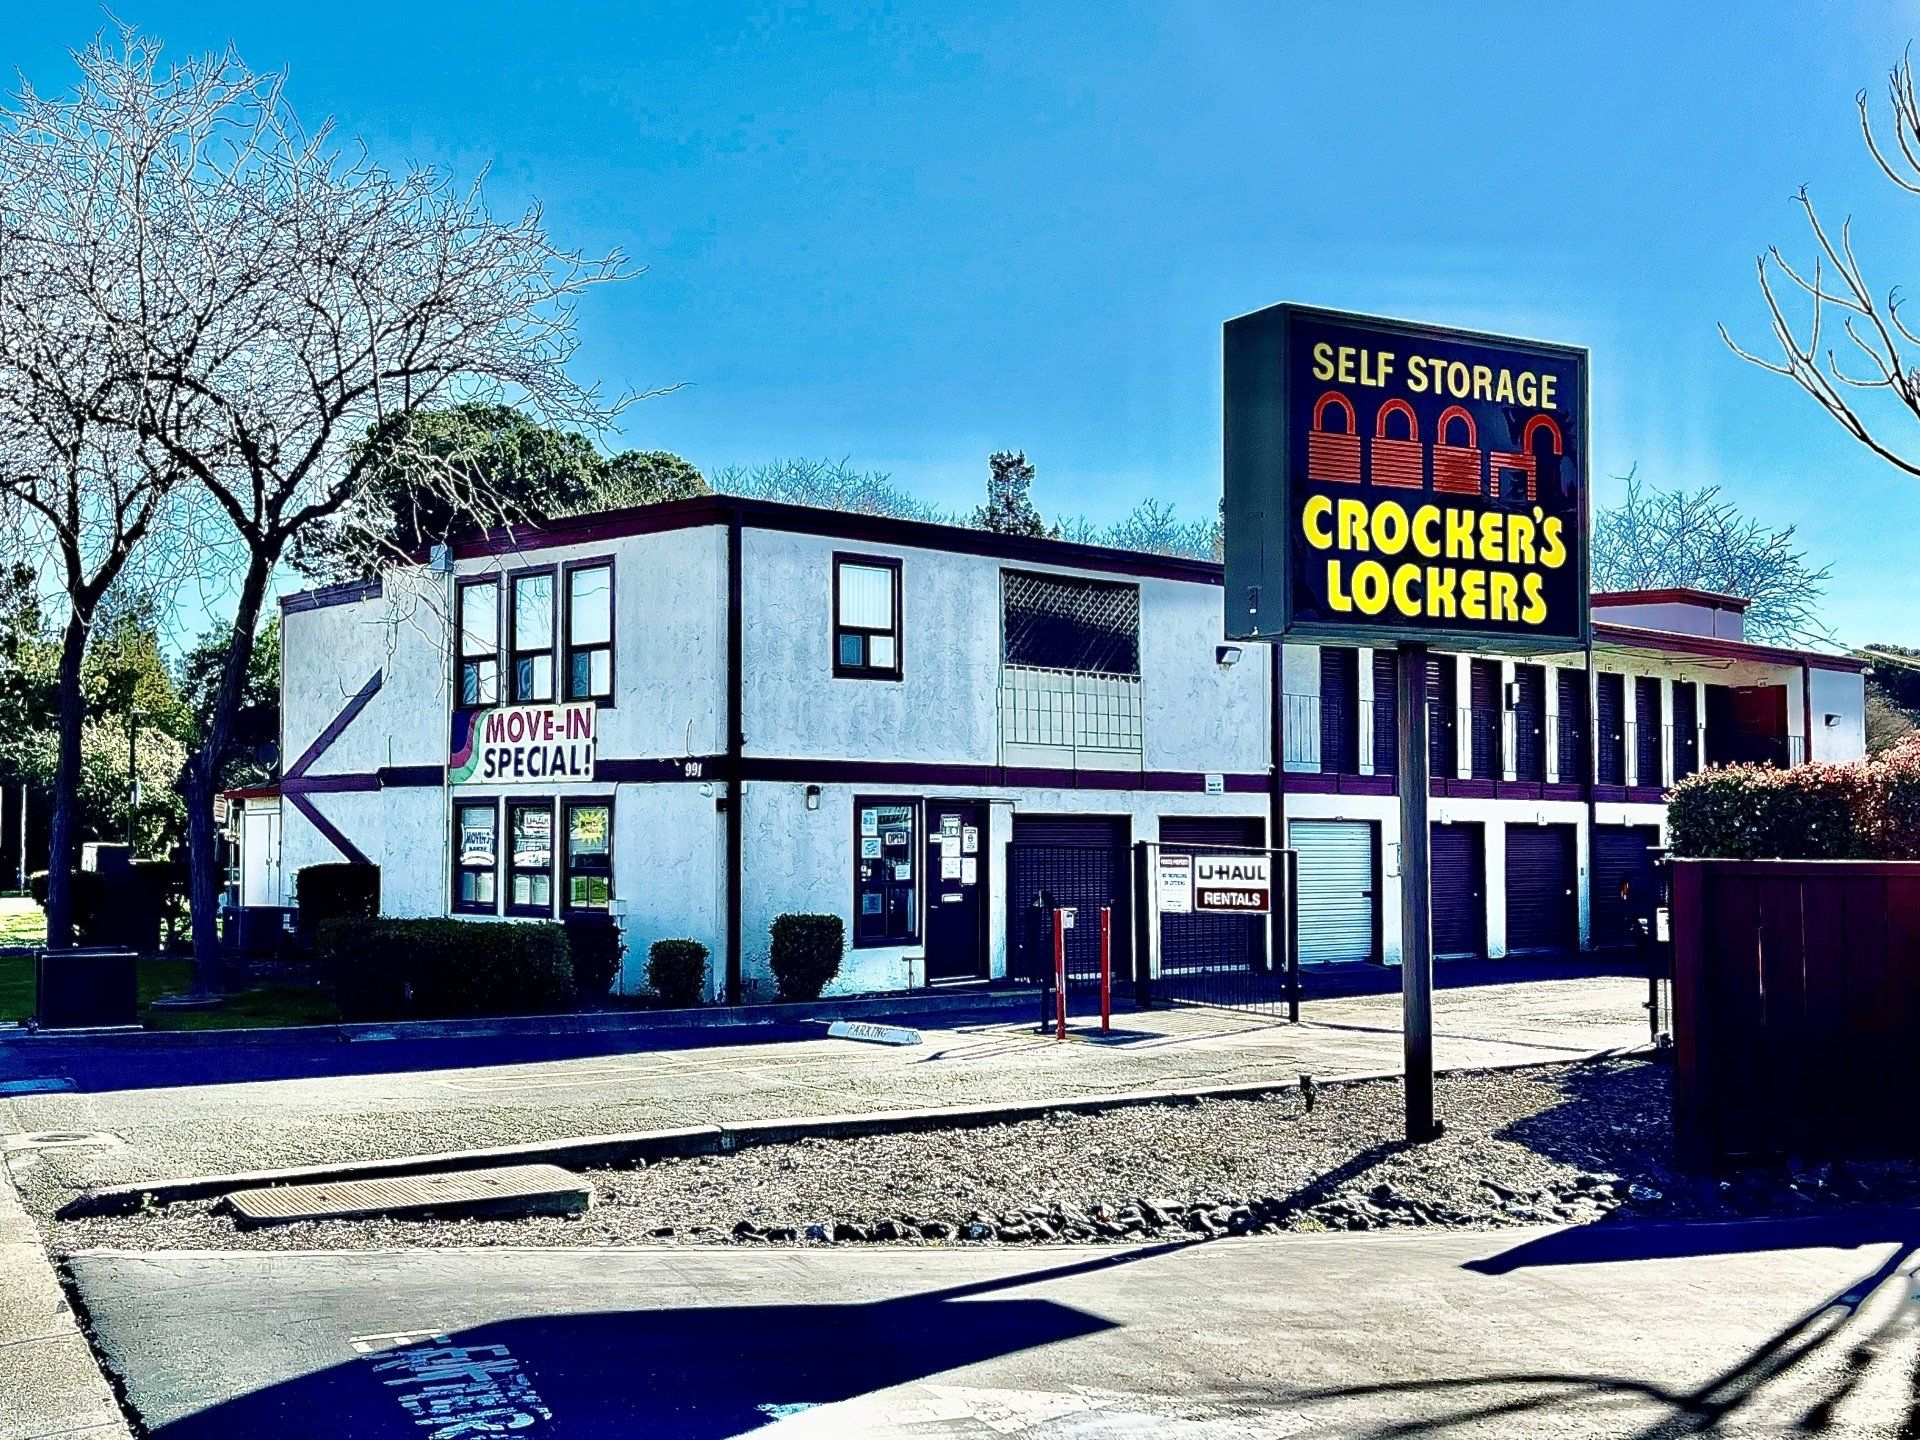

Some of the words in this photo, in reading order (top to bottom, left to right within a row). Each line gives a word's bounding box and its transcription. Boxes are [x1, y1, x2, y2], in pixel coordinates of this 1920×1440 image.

[1312, 342, 1395, 388] SELF
[1407, 355, 1558, 410] STORAGE
[1302, 494, 1567, 568] CROCKER'S
[1327, 560, 1548, 625] LOCKERS
[485, 707, 592, 744] MOVE-IN
[483, 744, 592, 779] SPECIAL!
[685, 762, 702, 778] 991
[1198, 864, 1267, 881] U-HAUL
[1203, 891, 1261, 907] RENTALS
[846, 1023, 888, 1039] PARKING
